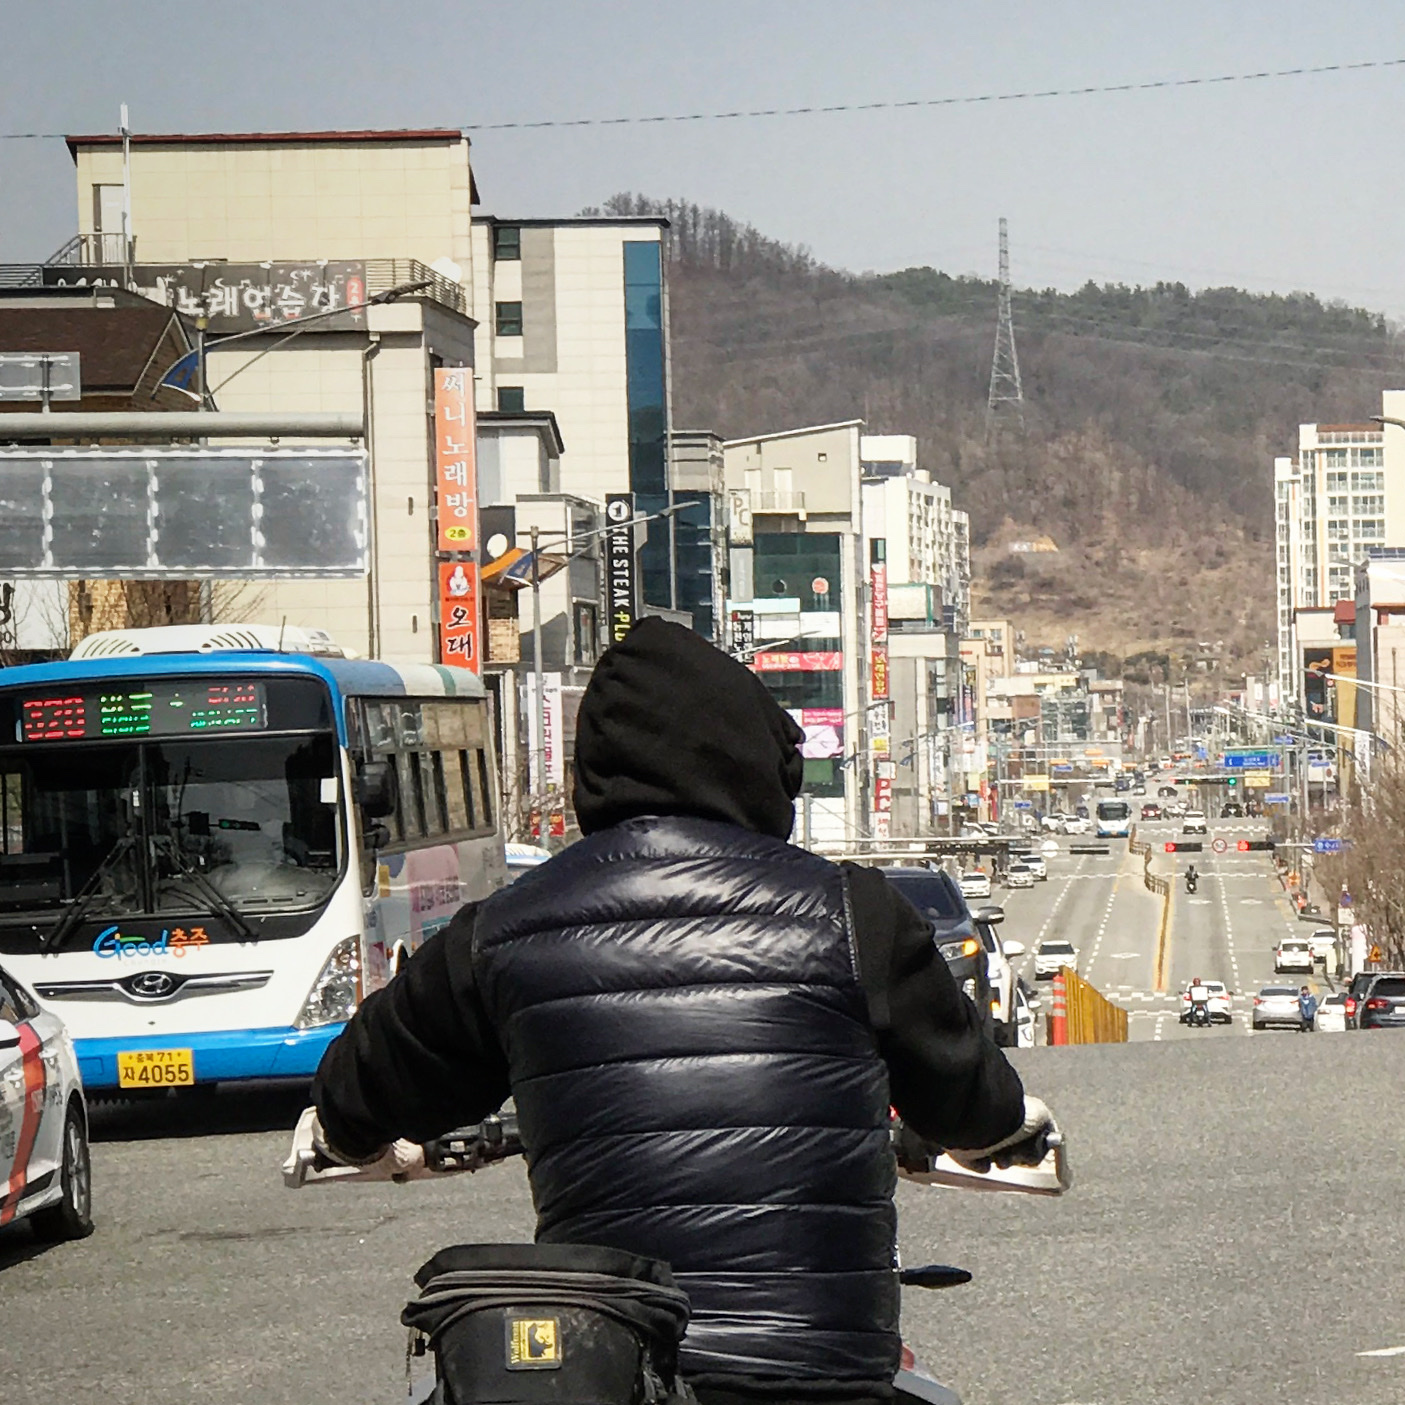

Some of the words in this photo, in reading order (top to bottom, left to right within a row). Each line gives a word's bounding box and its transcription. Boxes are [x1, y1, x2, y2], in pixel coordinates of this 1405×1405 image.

[612, 527, 629, 554] THE
[613, 558, 630, 608] STEAK
[169, 926, 210, 958] 충주
[158, 1051, 173, 1062] 71
